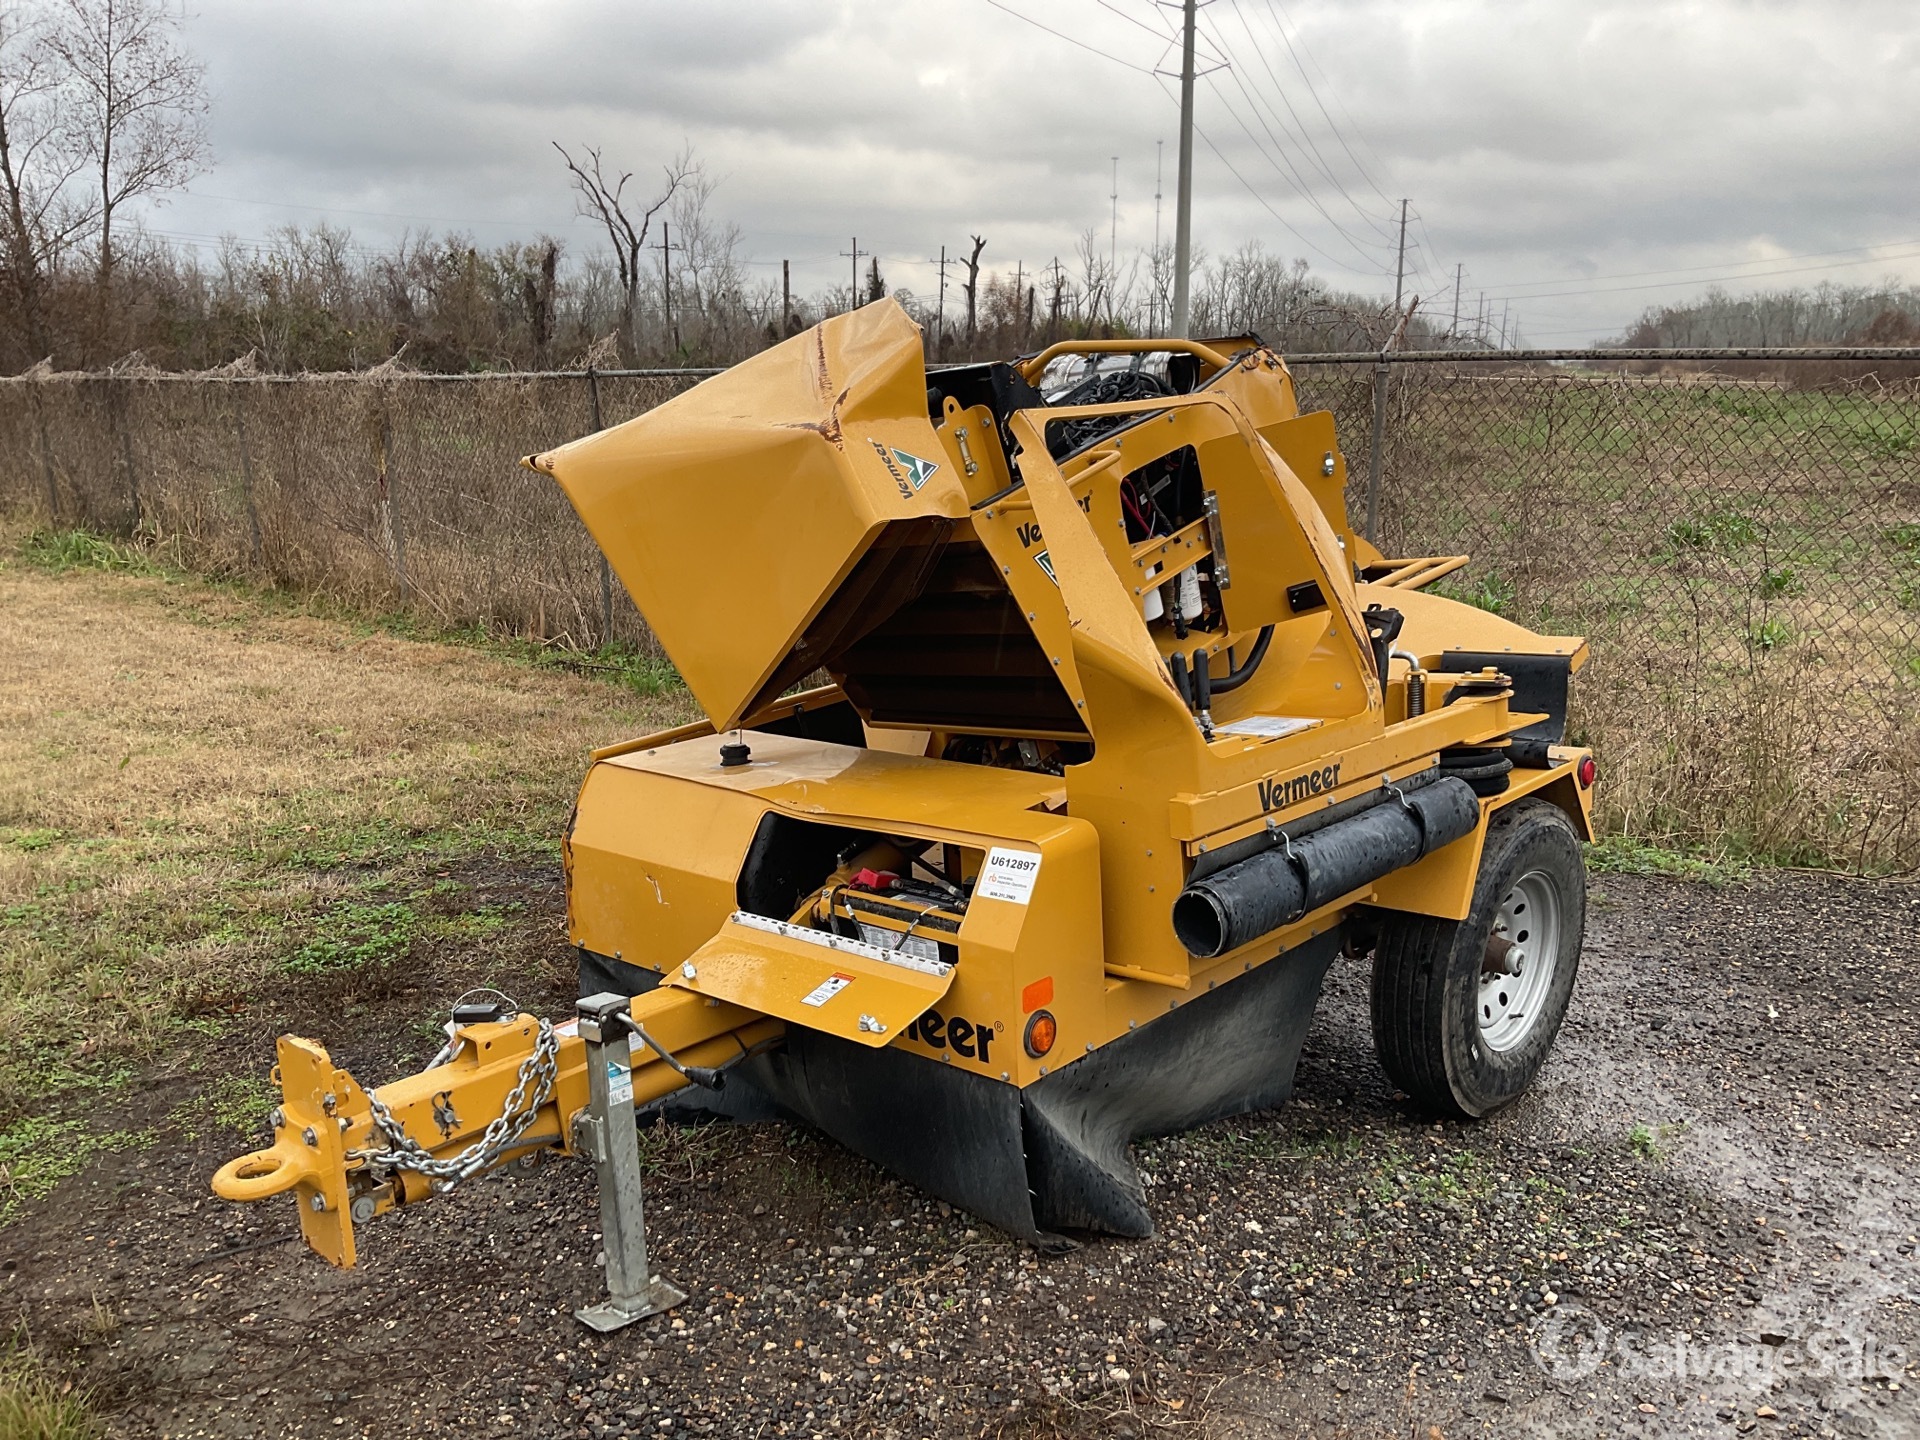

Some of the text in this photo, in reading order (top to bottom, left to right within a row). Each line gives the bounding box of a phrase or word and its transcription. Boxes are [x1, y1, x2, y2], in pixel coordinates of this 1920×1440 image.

[872, 441, 914, 500] Vermeer
[1257, 763, 1341, 812] Vermeer
[991, 855, 1037, 872] U612897
